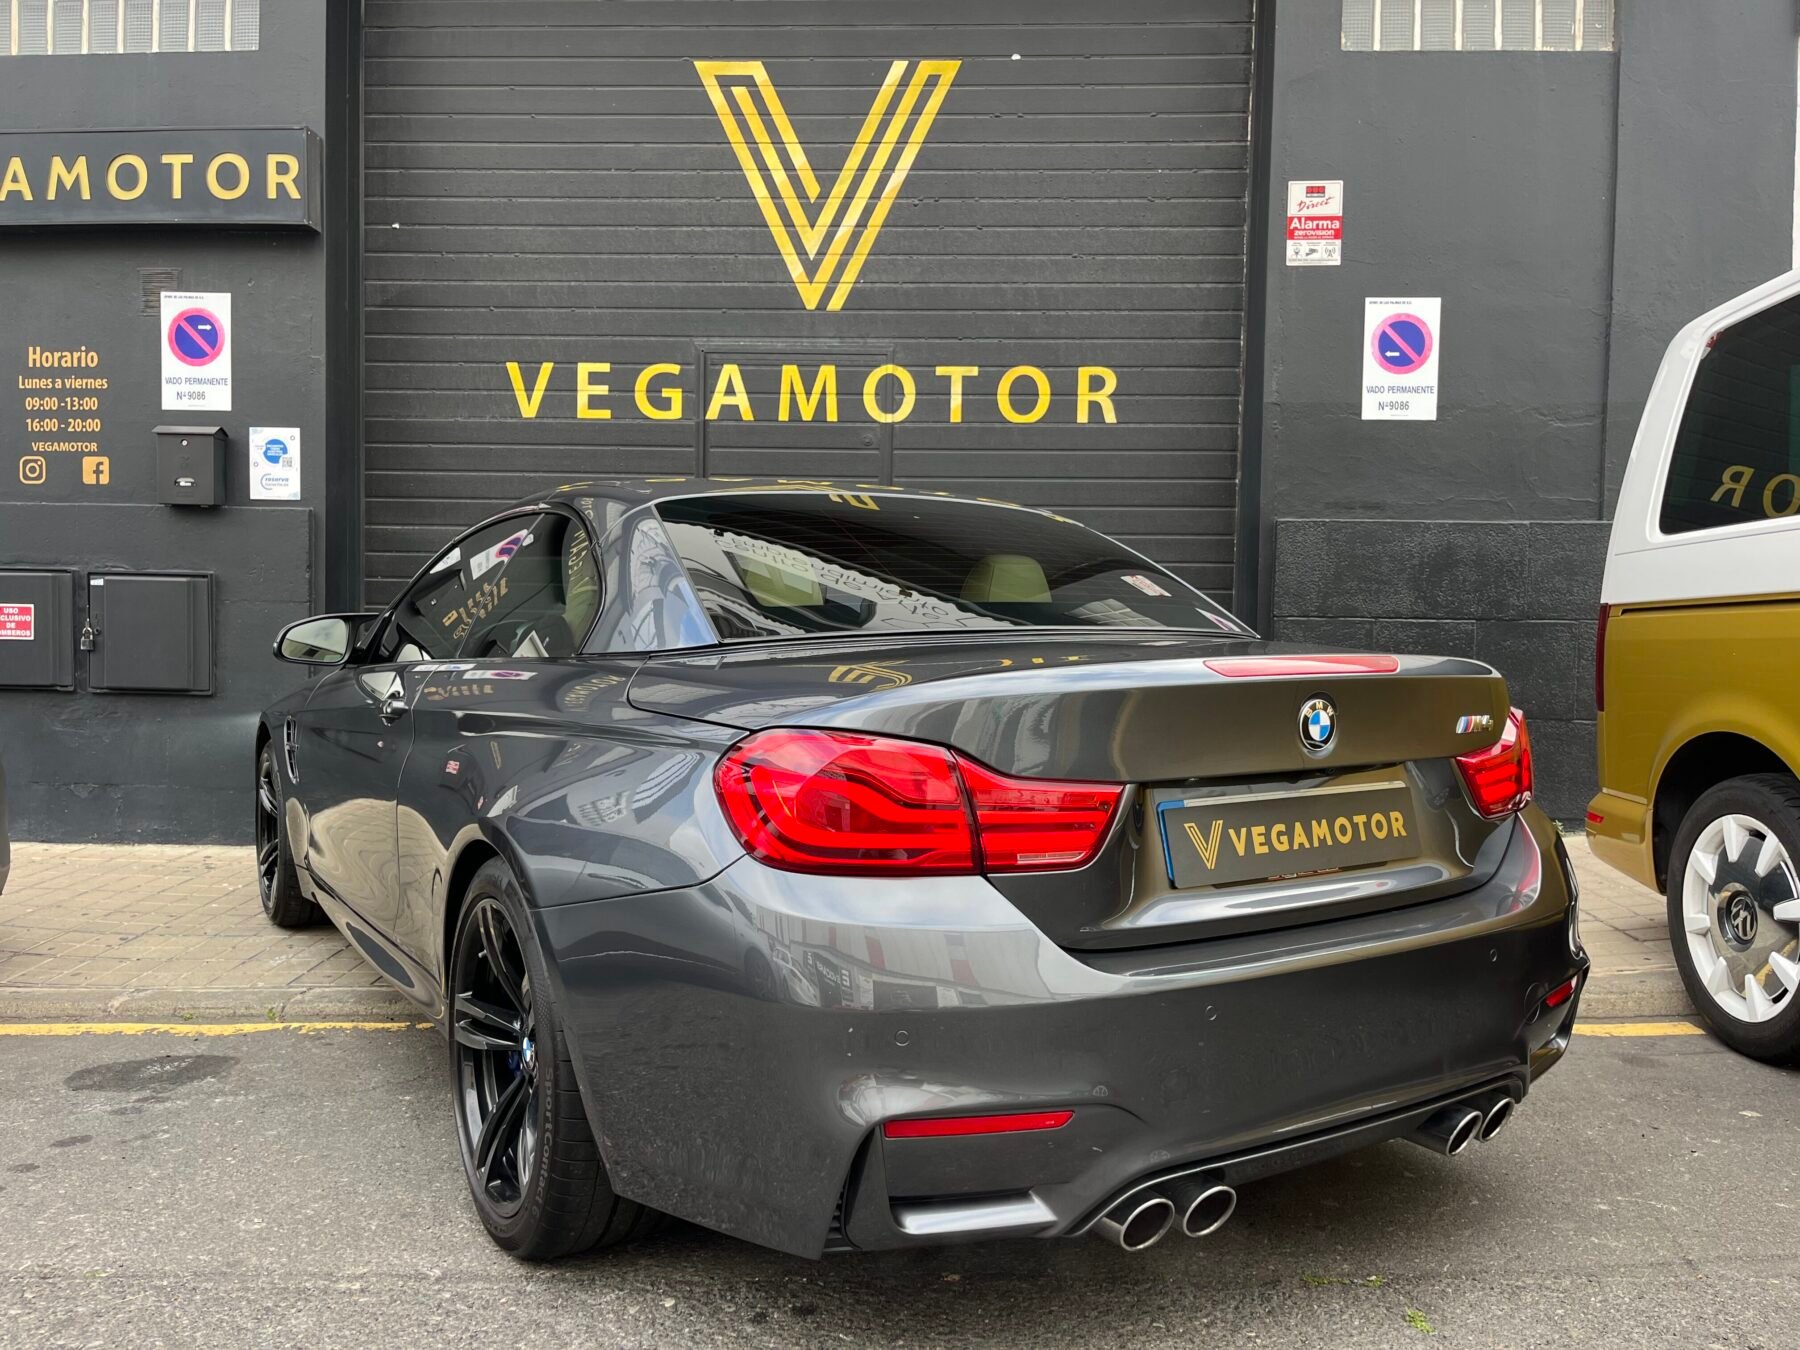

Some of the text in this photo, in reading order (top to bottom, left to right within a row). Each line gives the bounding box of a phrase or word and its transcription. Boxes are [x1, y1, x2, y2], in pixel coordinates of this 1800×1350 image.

[0, 153, 302, 201] AMOTOR
[1290, 216, 1340, 230] Alarma
[28, 345, 99, 368] Horario
[18, 375, 108, 389] Lunes a viernes
[165, 376, 229, 386] VADO PERMANENTE
[506, 362, 1118, 424] VEGAMOTOR
[1366, 385, 1435, 394] VADO PERMANENTE
[25, 397, 58, 411] 09:00
[26, 418, 58, 432] 16:00
[67, 418, 101, 432] 20:00
[32, 442, 98, 452] VEGAMOTOR
[1228, 811, 1407, 856] VEGAMOTOR
